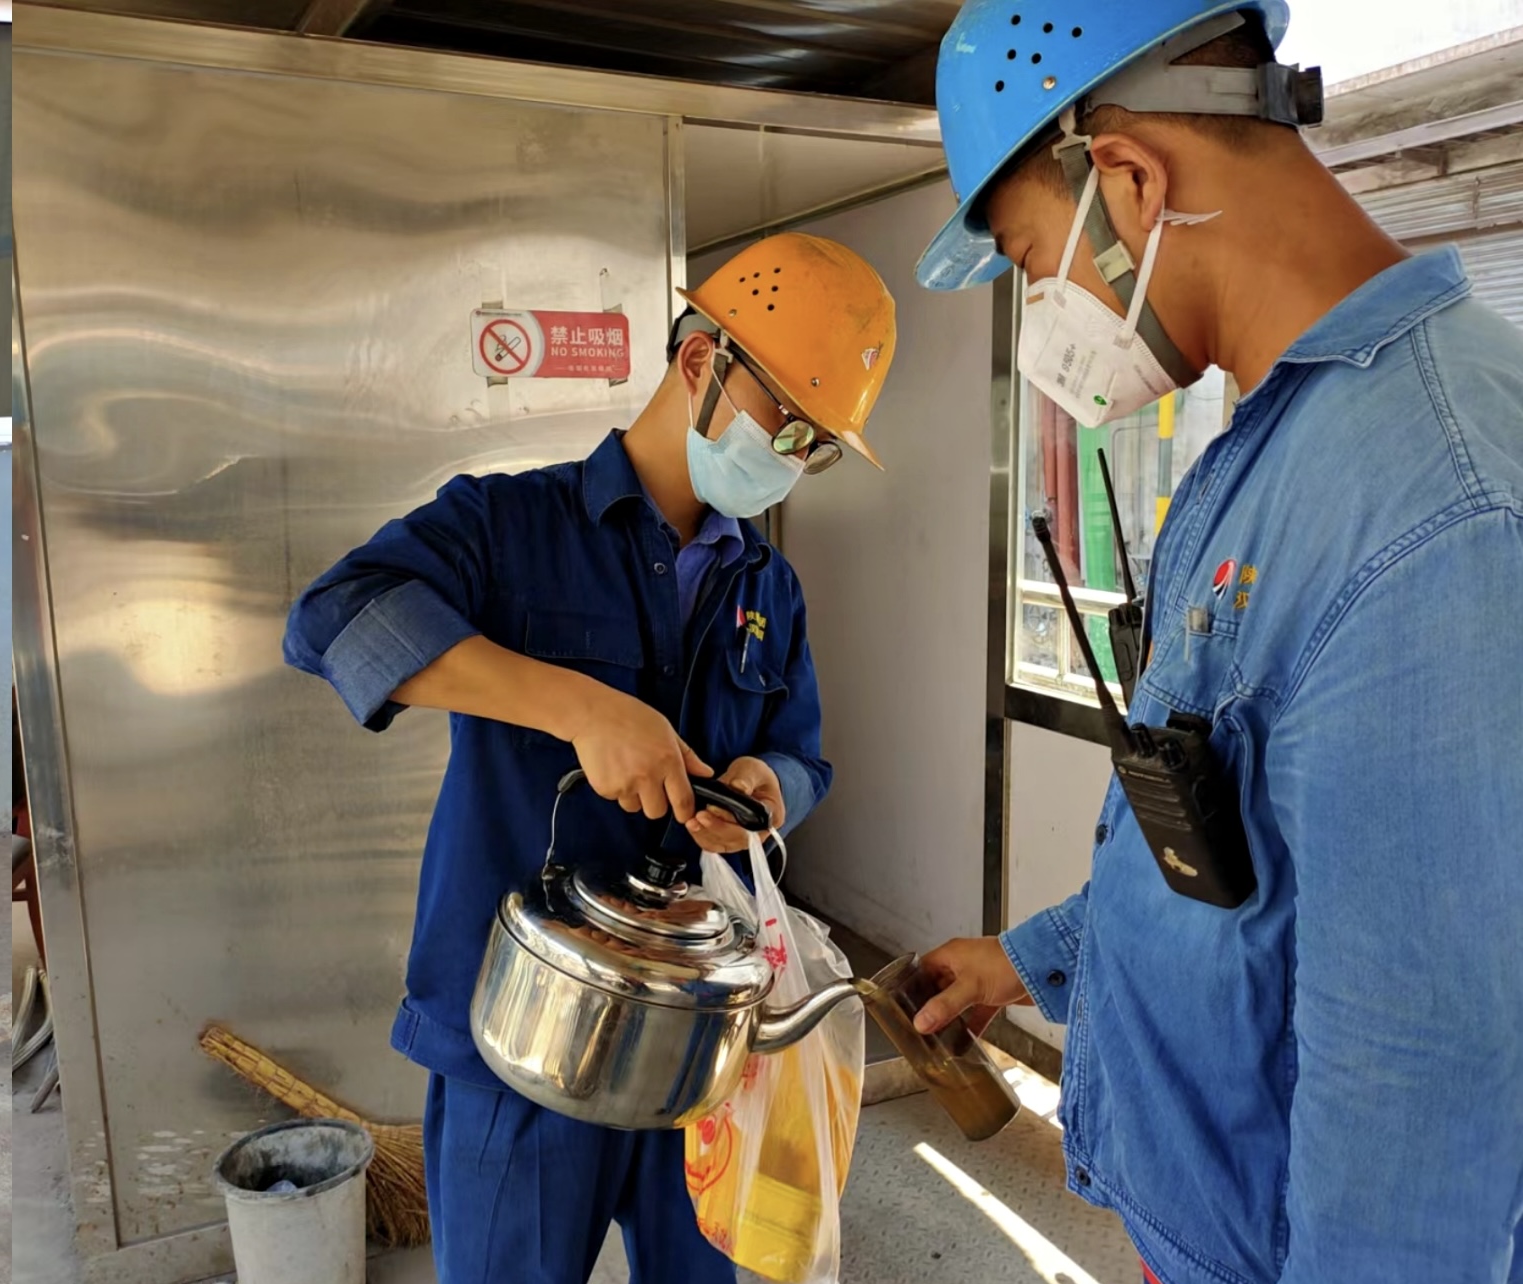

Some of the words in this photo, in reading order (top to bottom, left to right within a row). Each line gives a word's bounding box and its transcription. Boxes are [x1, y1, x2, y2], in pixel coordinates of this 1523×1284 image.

[550, 326, 624, 346] 禁止吸烟
[551, 347, 568, 357] NO
[571, 347, 625, 358] SMOKING
